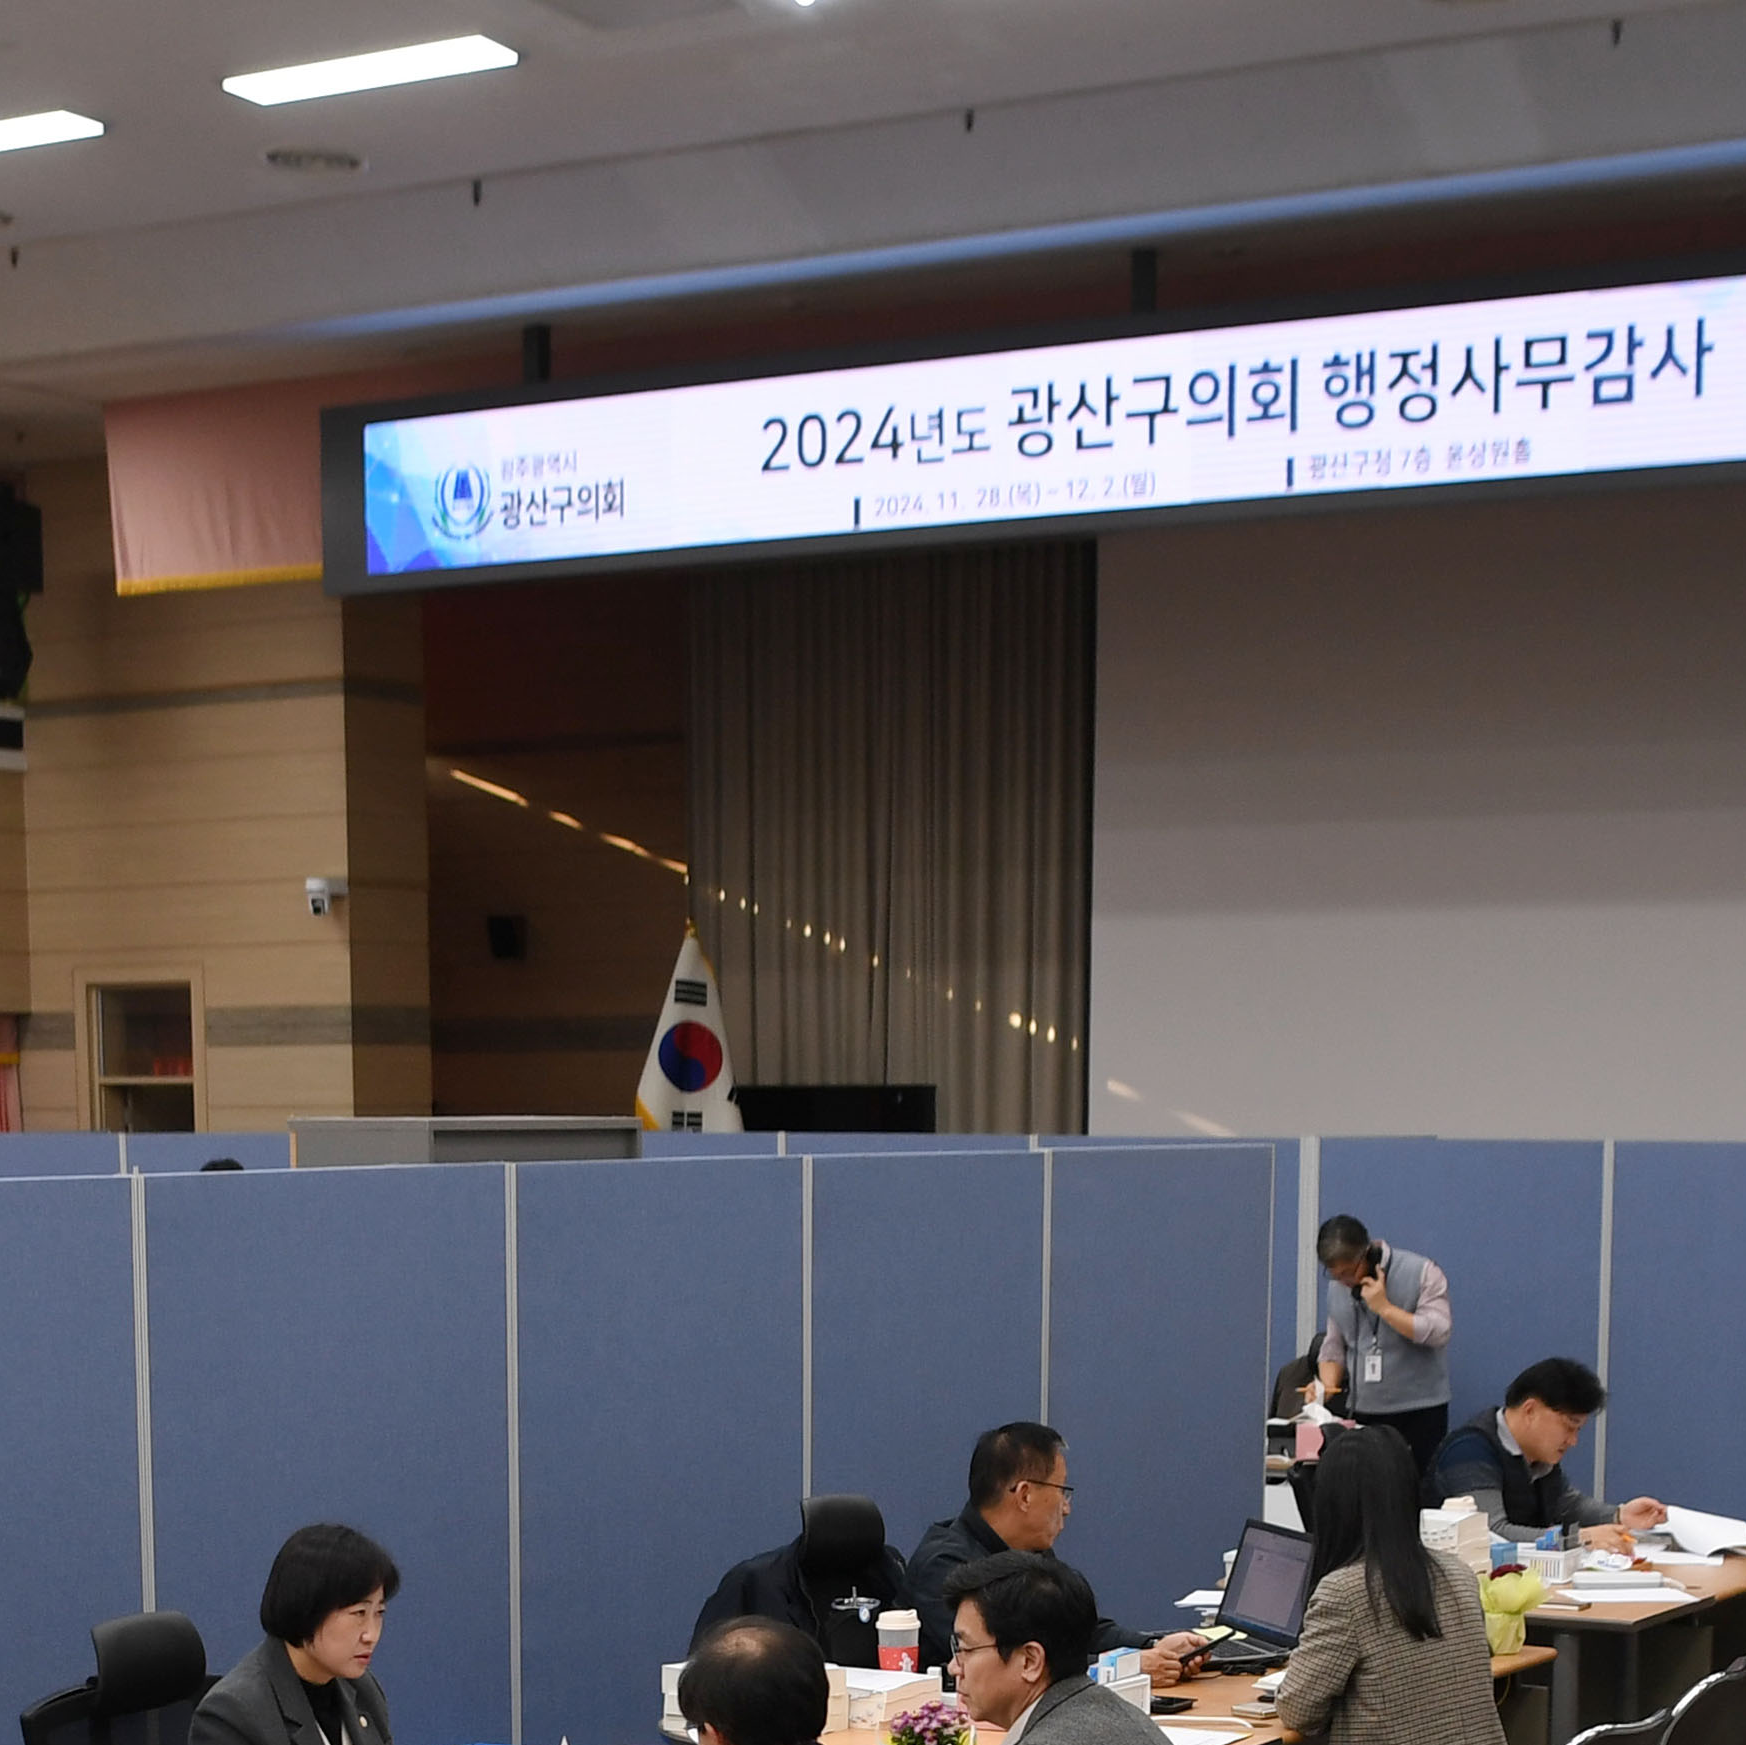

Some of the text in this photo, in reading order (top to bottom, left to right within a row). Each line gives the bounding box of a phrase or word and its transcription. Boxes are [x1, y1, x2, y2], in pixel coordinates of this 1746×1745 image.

[761, 316, 1715, 473] 2024년도 광산구의회 행정사무감사
[500, 477, 624, 529] 광산구의회
